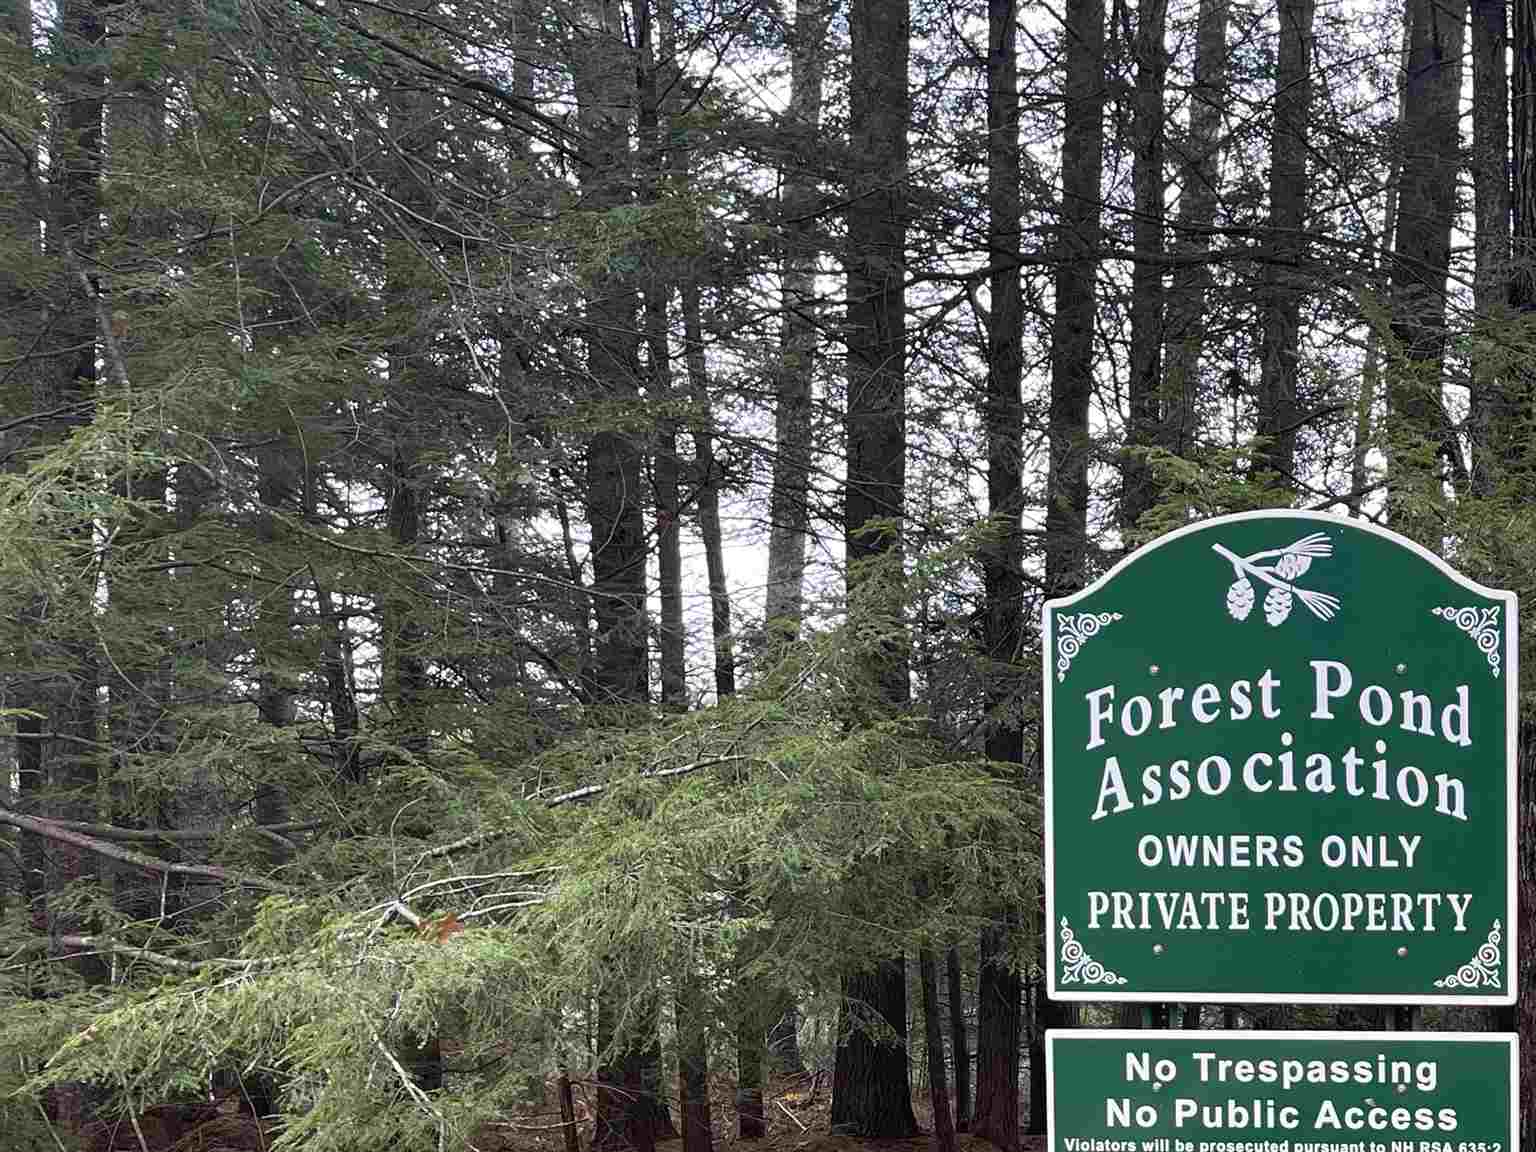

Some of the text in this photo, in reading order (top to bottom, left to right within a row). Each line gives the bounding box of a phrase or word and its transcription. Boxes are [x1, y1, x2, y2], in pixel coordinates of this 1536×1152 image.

[1085, 660, 1472, 751] Forest Pond
[1090, 731, 1469, 821] Association
[1137, 834, 1422, 868] OWNERS ONLY
[1087, 891, 1473, 932] PRIVATE PROPERTY
[1125, 1052, 1438, 1090] No Trespassing
[1106, 1098, 1458, 1131] No Public Access
[1063, 1137, 1137, 1152] Violators
[1141, 1138, 1168, 1152] will
[1174, 1138, 1195, 1152] be
